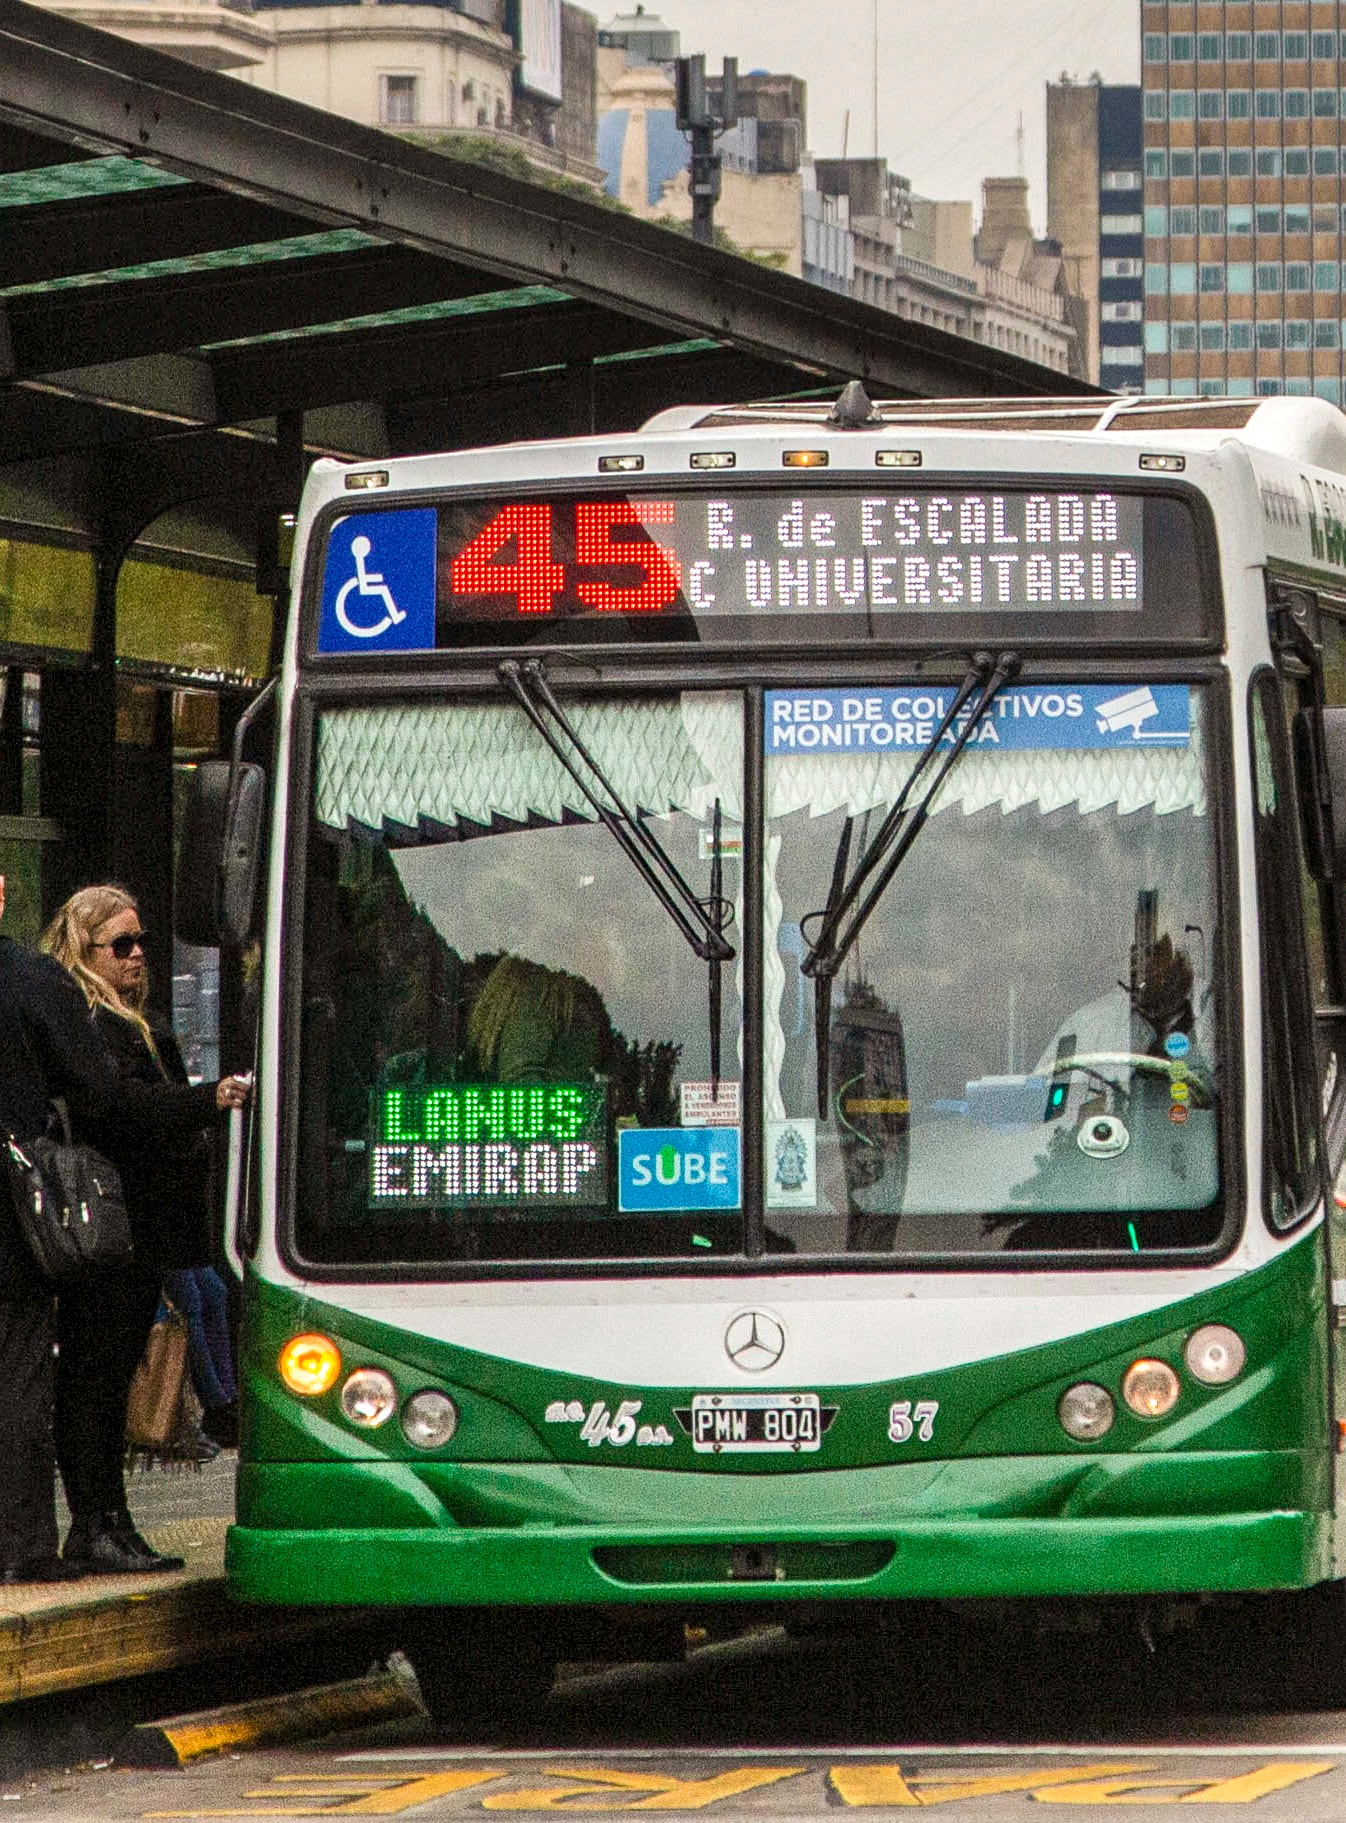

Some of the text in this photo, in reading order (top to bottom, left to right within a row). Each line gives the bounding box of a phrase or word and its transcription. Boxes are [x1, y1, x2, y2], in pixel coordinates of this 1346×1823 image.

[708, 494, 1117, 549] R. de ESCALADA
[452, 504, 682, 612] 45
[690, 552, 1138, 609] C UNIVERSITARIA
[772, 698, 834, 723] RED
[842, 697, 883, 721] DE
[772, 720, 1000, 748] MONITOREADA
[385, 1089, 583, 1141] LANUS
[373, 1143, 597, 1196] EMIRAP
[632, 1144, 728, 1186] SUBE
[579, 1400, 643, 1447] 45
[698, 1409, 747, 1442] PMW
[764, 1409, 814, 1442] 804
[888, 1401, 940, 1442] 57
